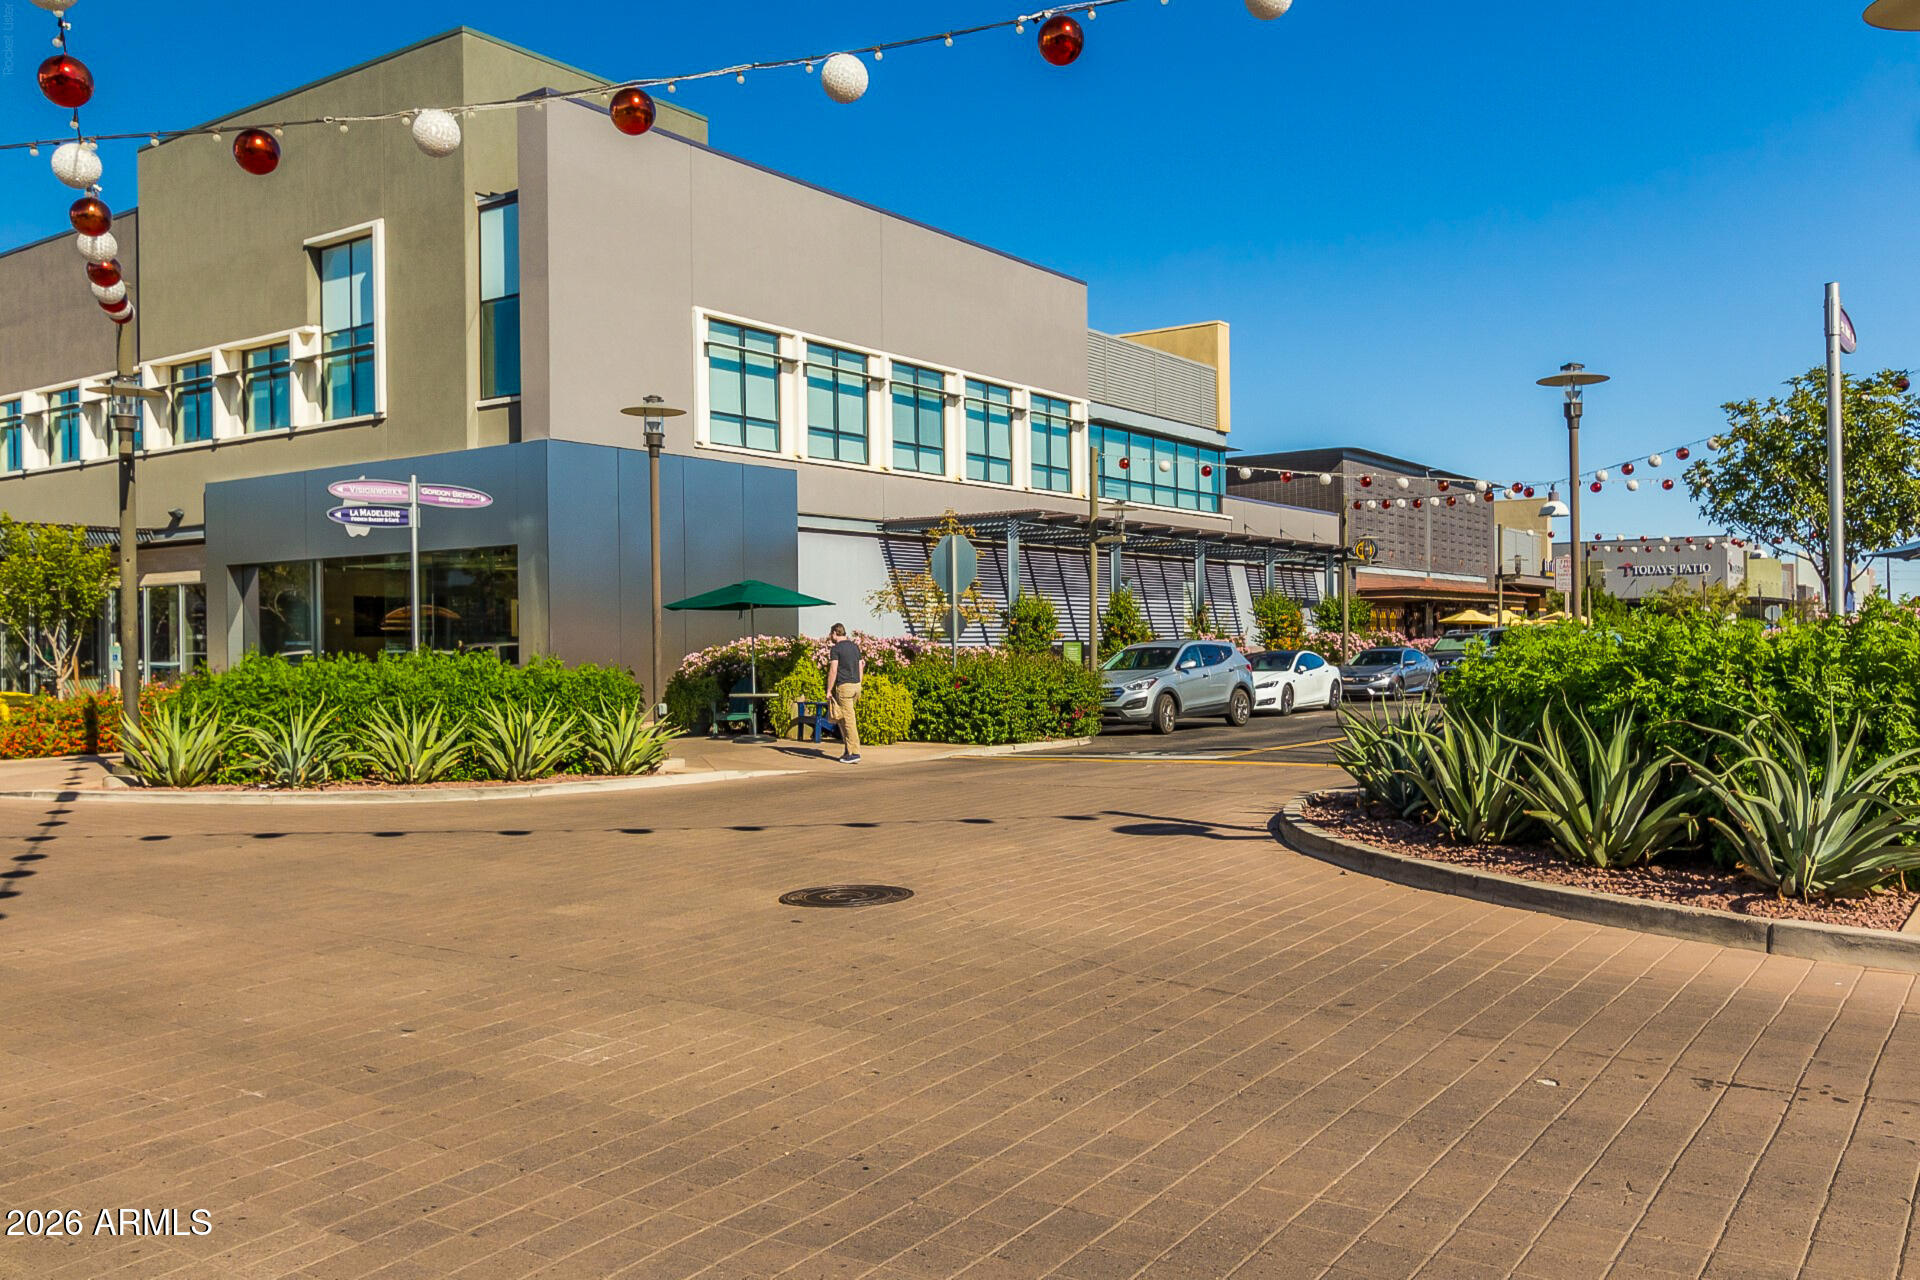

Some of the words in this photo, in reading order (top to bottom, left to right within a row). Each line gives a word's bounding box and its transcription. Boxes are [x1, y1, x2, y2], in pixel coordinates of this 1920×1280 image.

[421, 487, 450, 497] GORDON
[350, 509, 359, 517] LA
[360, 509, 400, 518] MADELEINE
[1679, 562, 1711, 573] PATIO
